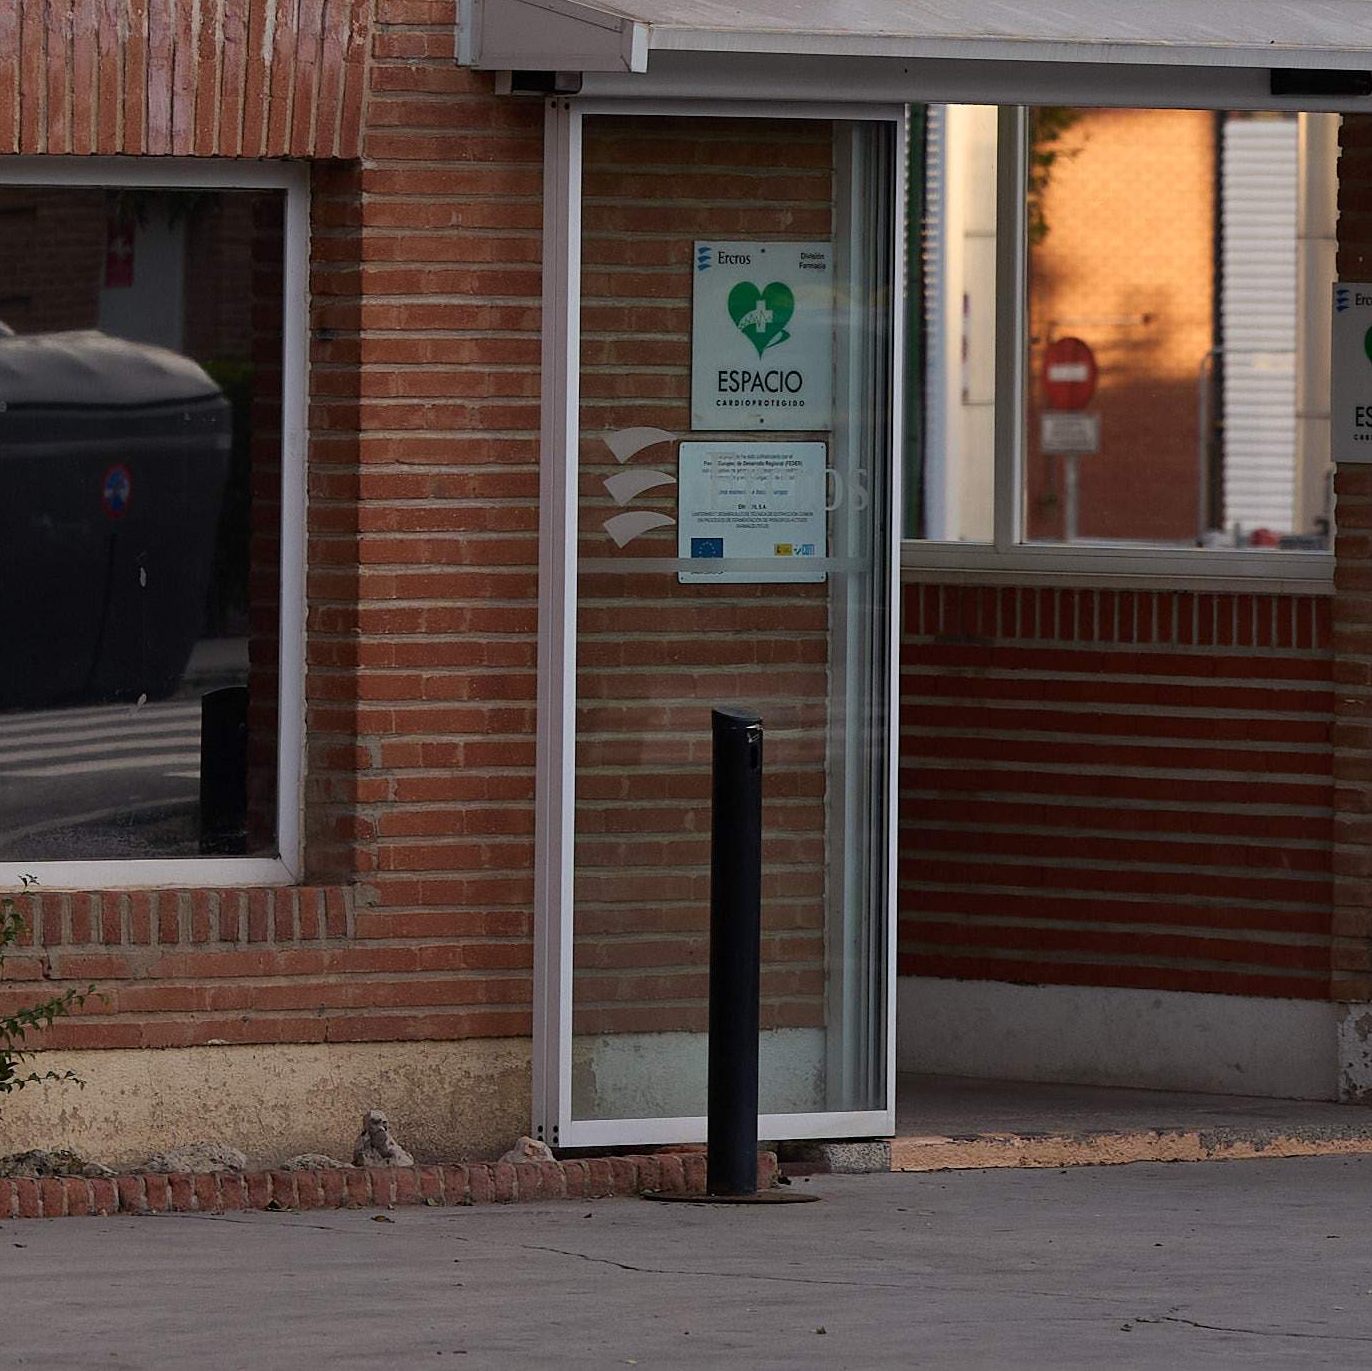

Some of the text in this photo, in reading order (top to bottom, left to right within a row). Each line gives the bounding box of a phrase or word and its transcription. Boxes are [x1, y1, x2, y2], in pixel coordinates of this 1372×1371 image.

[717, 251, 751, 266] Ercros
[717, 370, 803, 393] ESPACIO
[715, 399, 806, 407] CARDIOPROTEGIDO
